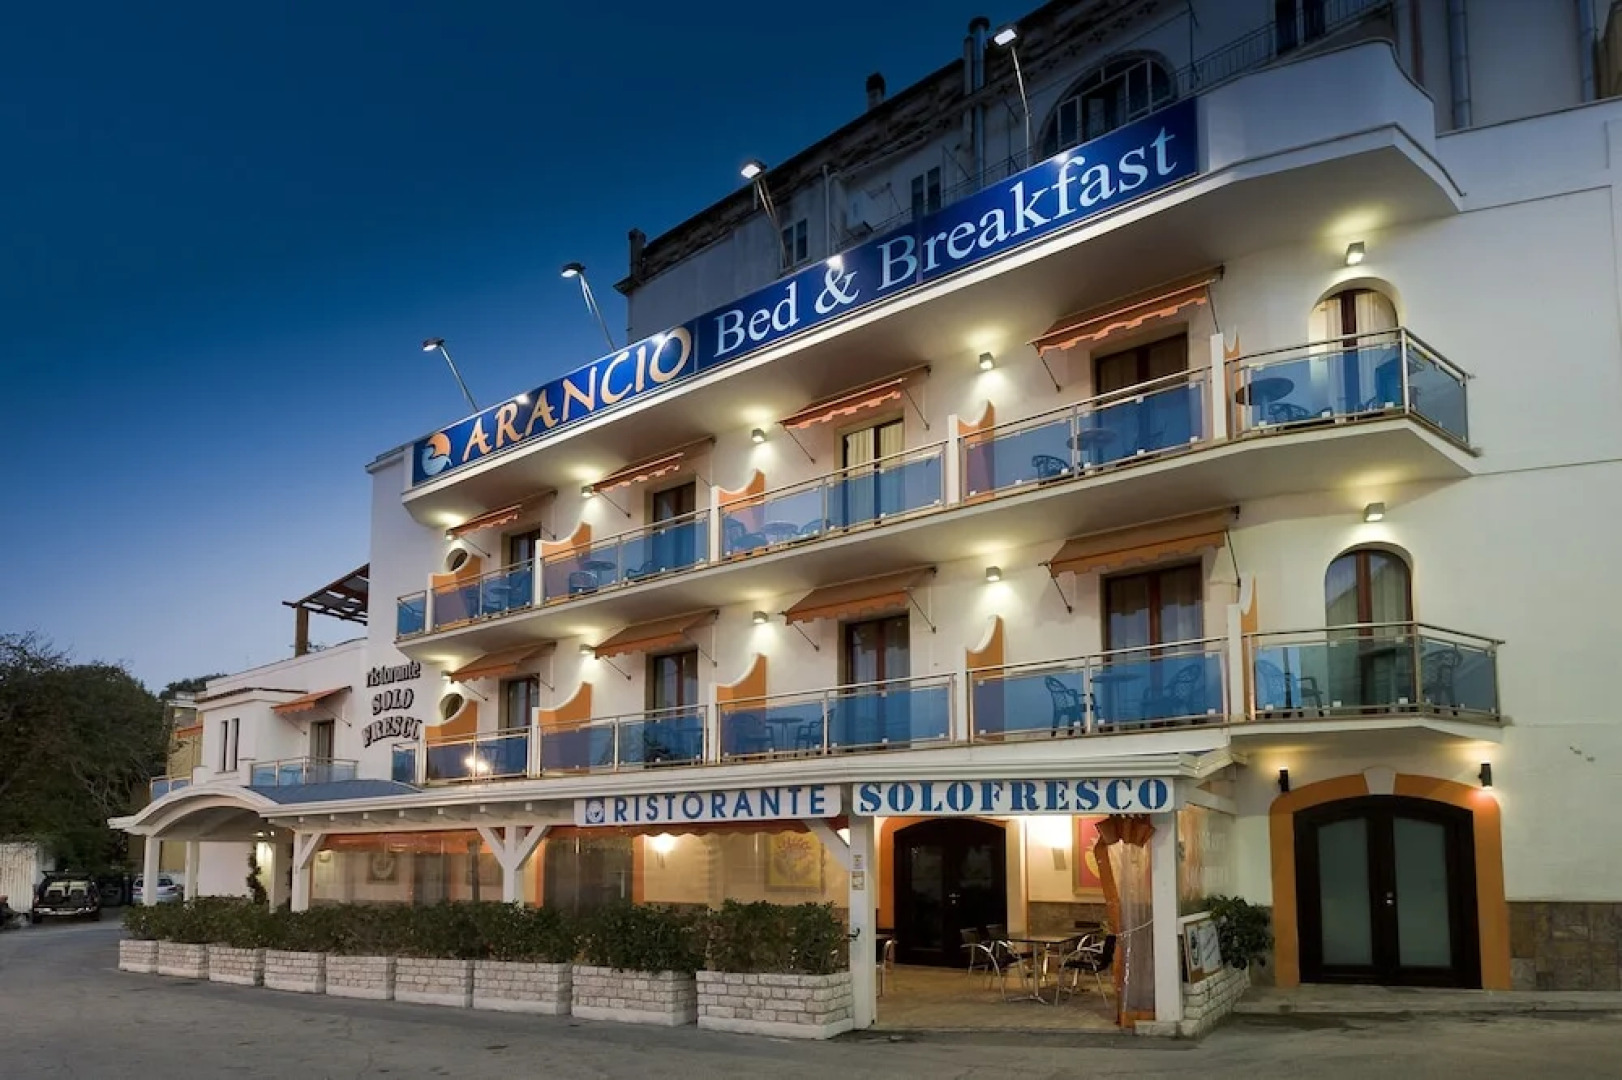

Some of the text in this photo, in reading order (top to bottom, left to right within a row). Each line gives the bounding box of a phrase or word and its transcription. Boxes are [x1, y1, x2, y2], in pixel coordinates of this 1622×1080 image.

[462, 126, 1177, 461] ARANCIO Bed & Breakfast
[366, 660, 421, 688] ristorante
[372, 688, 414, 716] SOLO
[614, 785, 825, 823] RISTORANTE
[860, 779, 1169, 812] SOLOFRESCO
